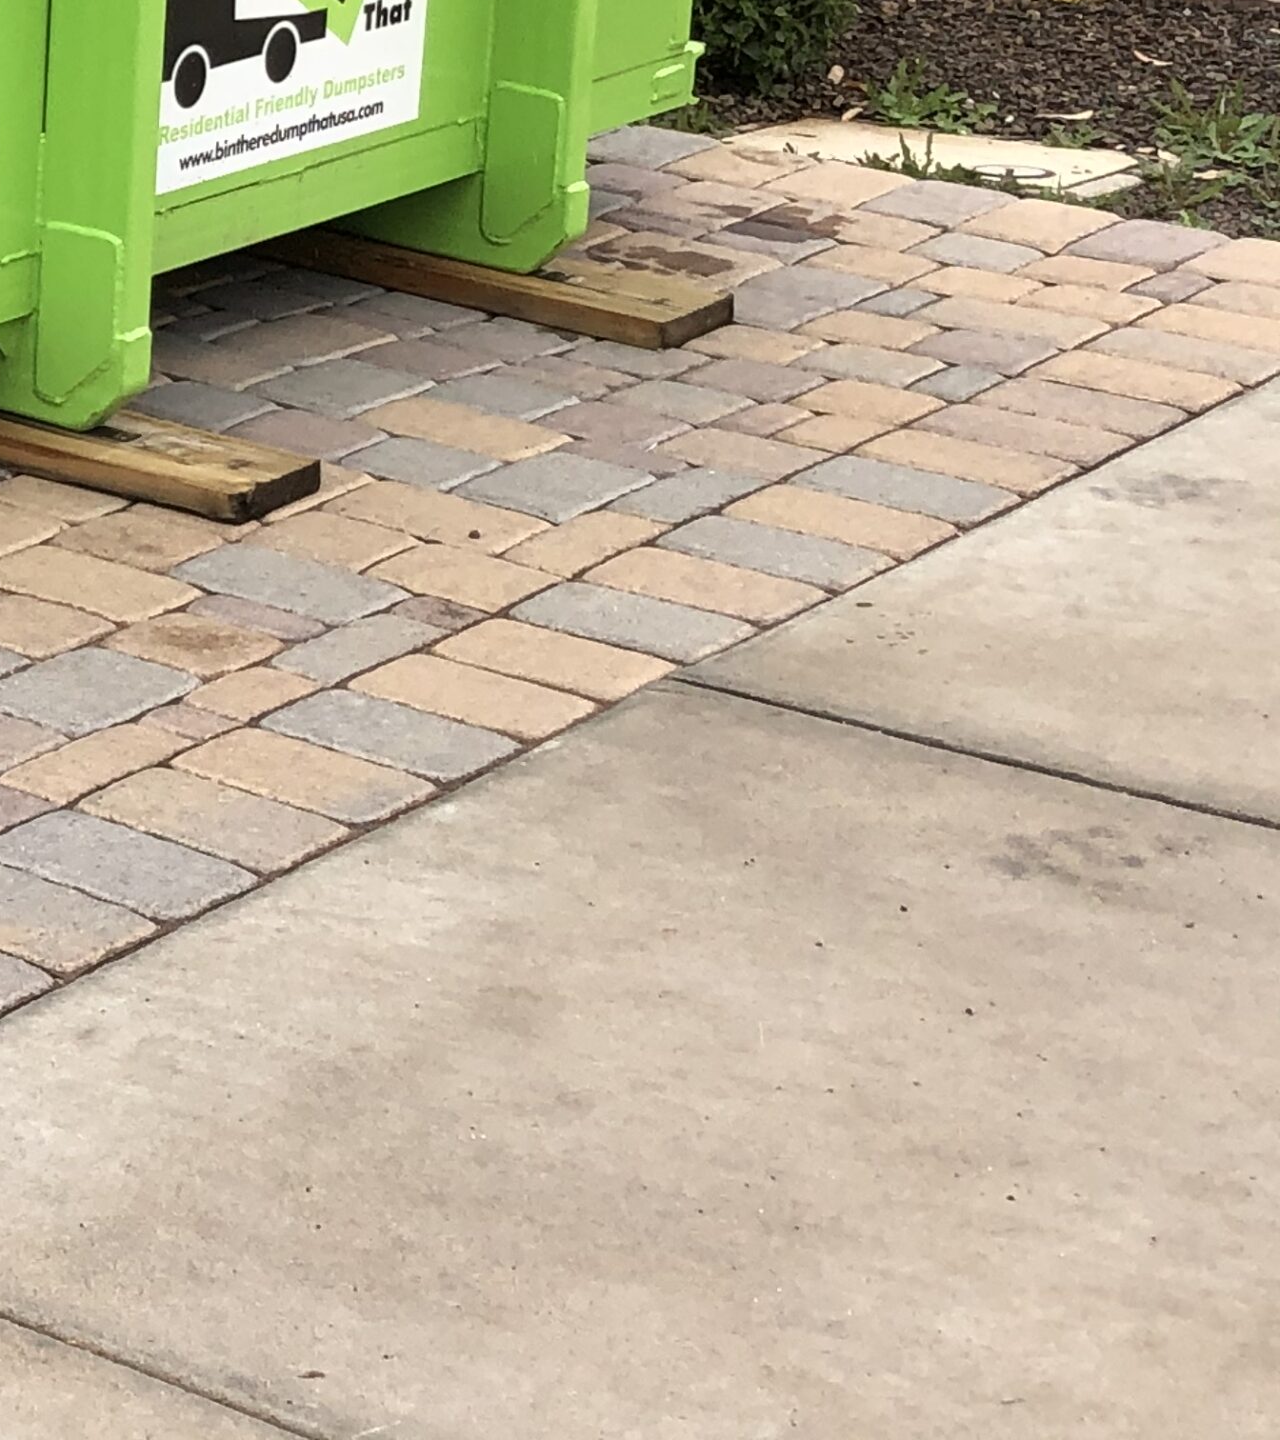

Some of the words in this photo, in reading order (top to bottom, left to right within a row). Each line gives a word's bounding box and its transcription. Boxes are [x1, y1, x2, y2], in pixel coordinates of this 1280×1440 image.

[160, 105, 250, 145] Residential
[255, 85, 319, 119] Friendly
[323, 63, 406, 100] Dumpsters
[179, 101, 384, 171] www.bintheredumpthatusa.com
